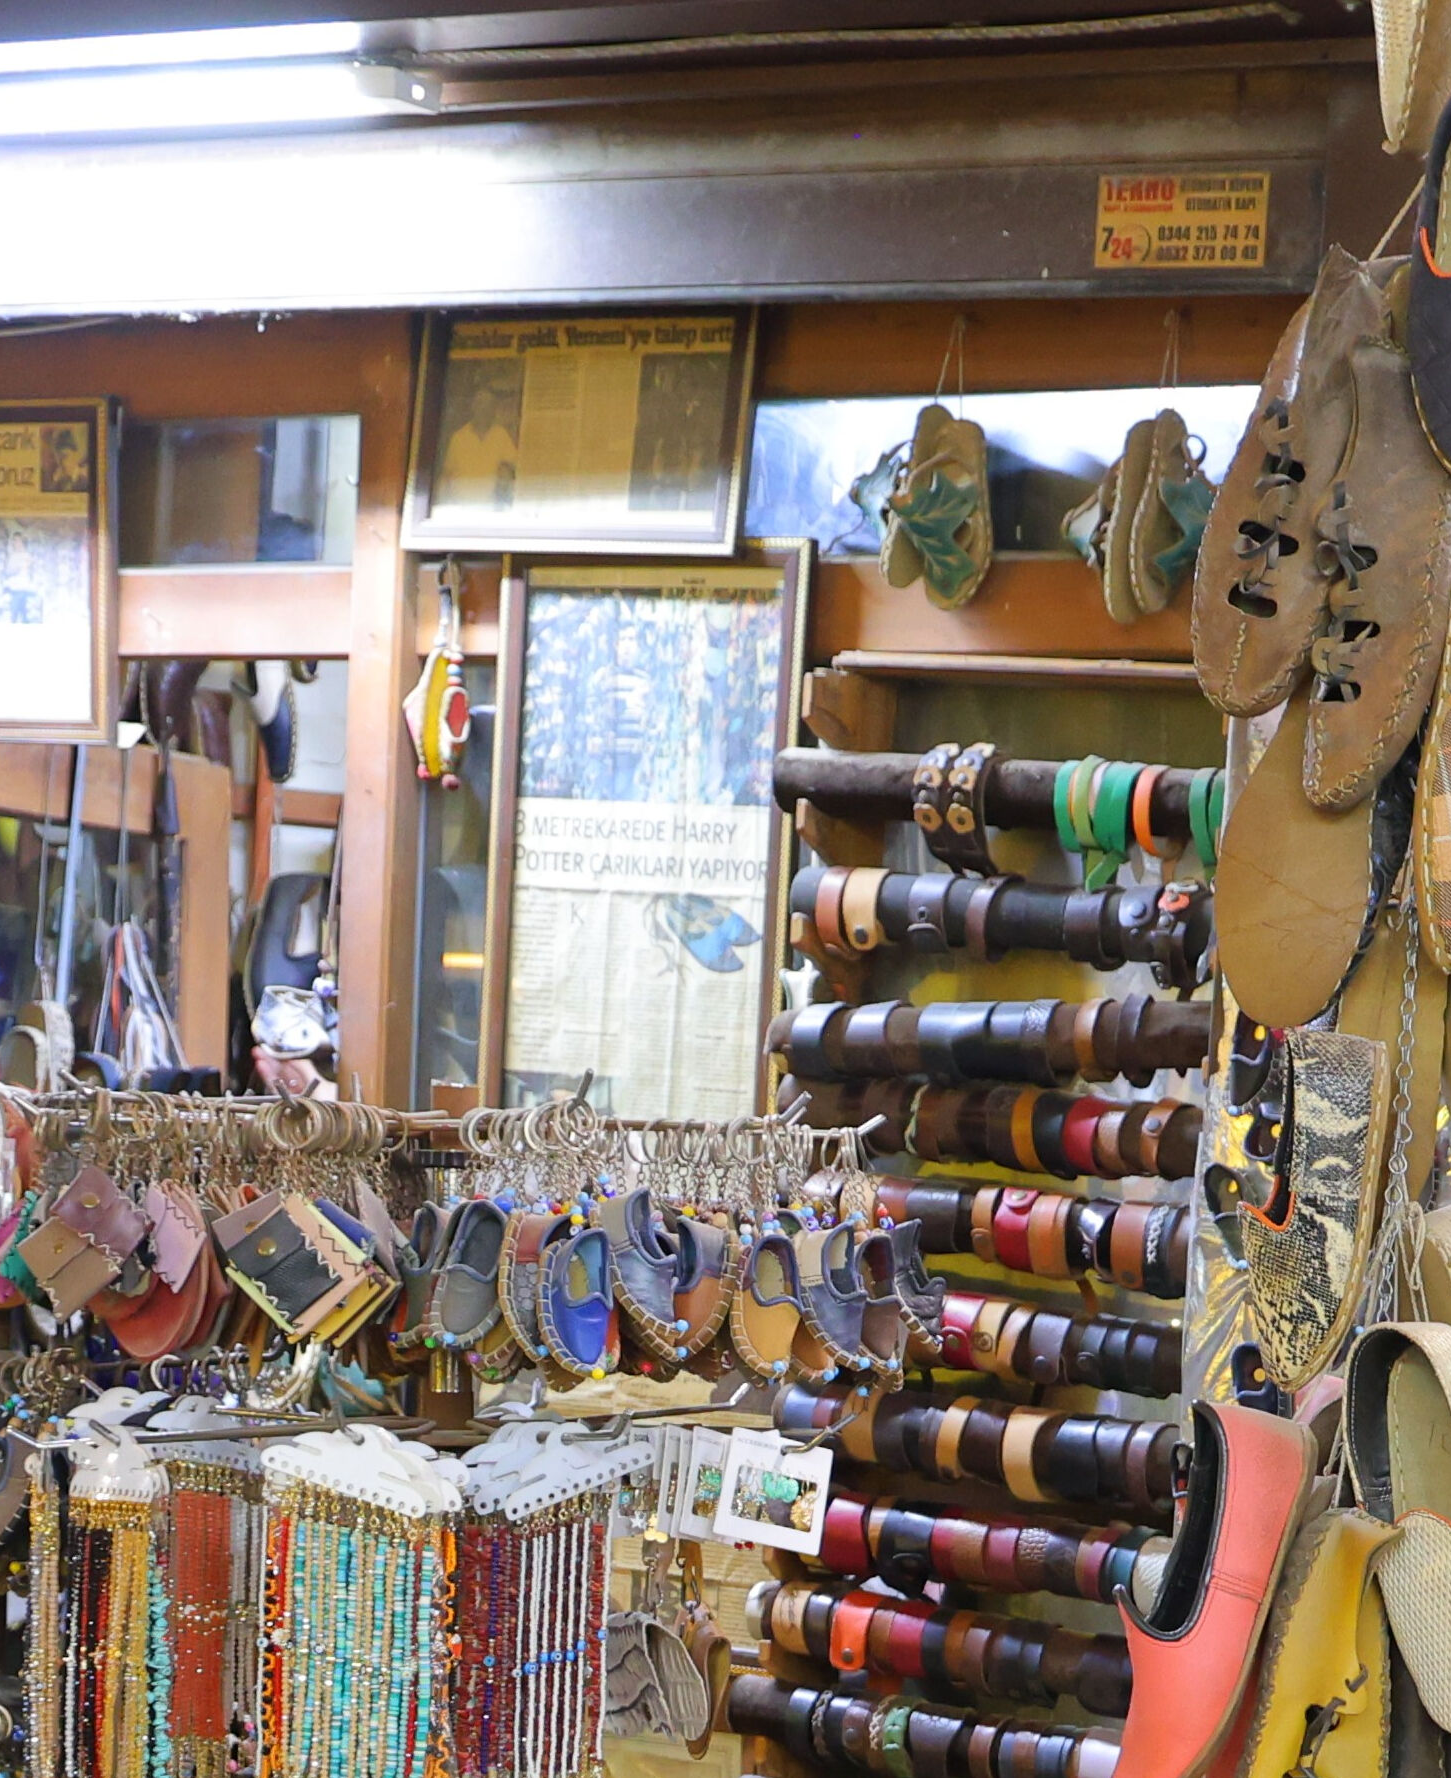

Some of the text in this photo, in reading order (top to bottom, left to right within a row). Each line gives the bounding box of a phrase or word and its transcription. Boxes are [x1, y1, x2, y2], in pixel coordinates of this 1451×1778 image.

[1158, 225, 1191, 241] 0344
[1223, 224, 1239, 240] 74
[1244, 224, 1260, 240] 74
[532, 814, 666, 842] METREKAREDE
[590, 852, 685, 881] ÇARIKLARI
[687, 857, 768, 883] YAPIYOR
